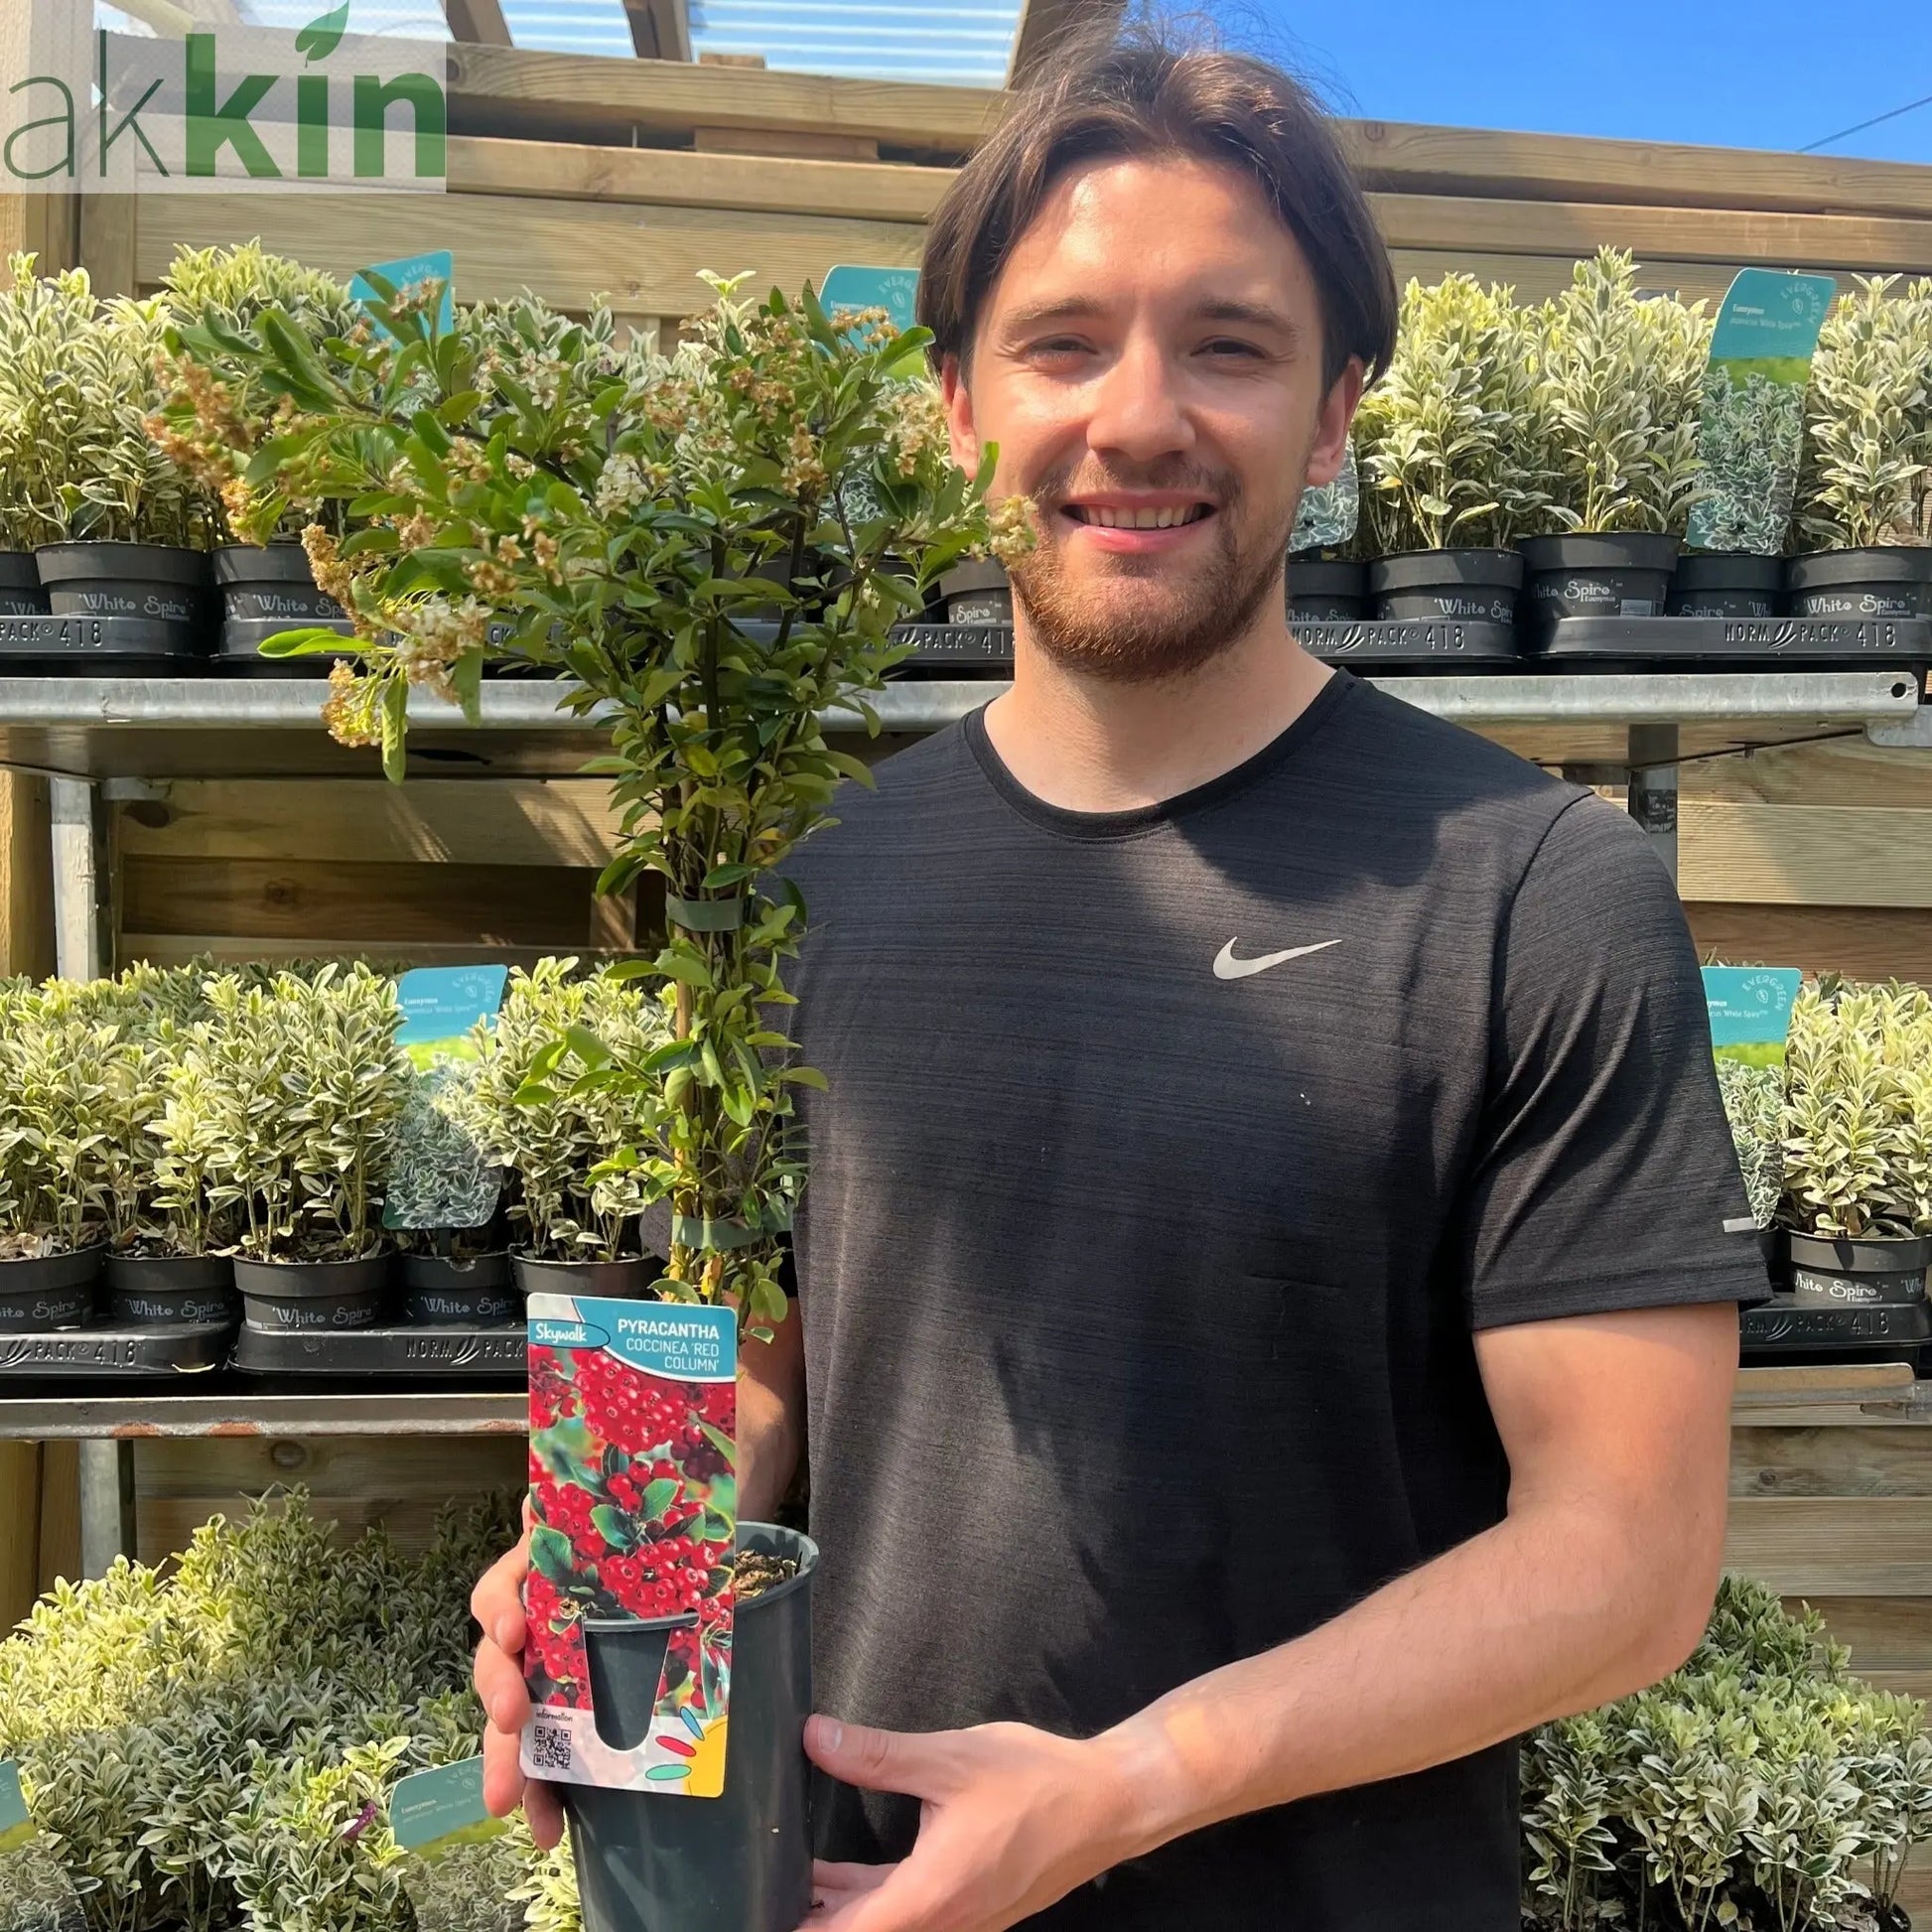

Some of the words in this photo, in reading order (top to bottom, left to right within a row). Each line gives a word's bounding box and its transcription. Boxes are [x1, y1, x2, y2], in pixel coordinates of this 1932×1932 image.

[59, 620, 102, 646] 418
[1424, 624, 1465, 650] 418
[1725, 622, 1771, 642] NORM
[1856, 621, 1897, 647] 418
[1741, 974, 1787, 1011] EVERGREEN
[535, 1322, 588, 1343] Skywalk
[618, 1317, 720, 1340] PYRACANTHA
[1851, 1311, 1889, 1335] 418
[93, 1340, 136, 1366] 418
[406, 1337, 453, 1358] NORM
[625, 1336, 689, 1355] COCCINEA
